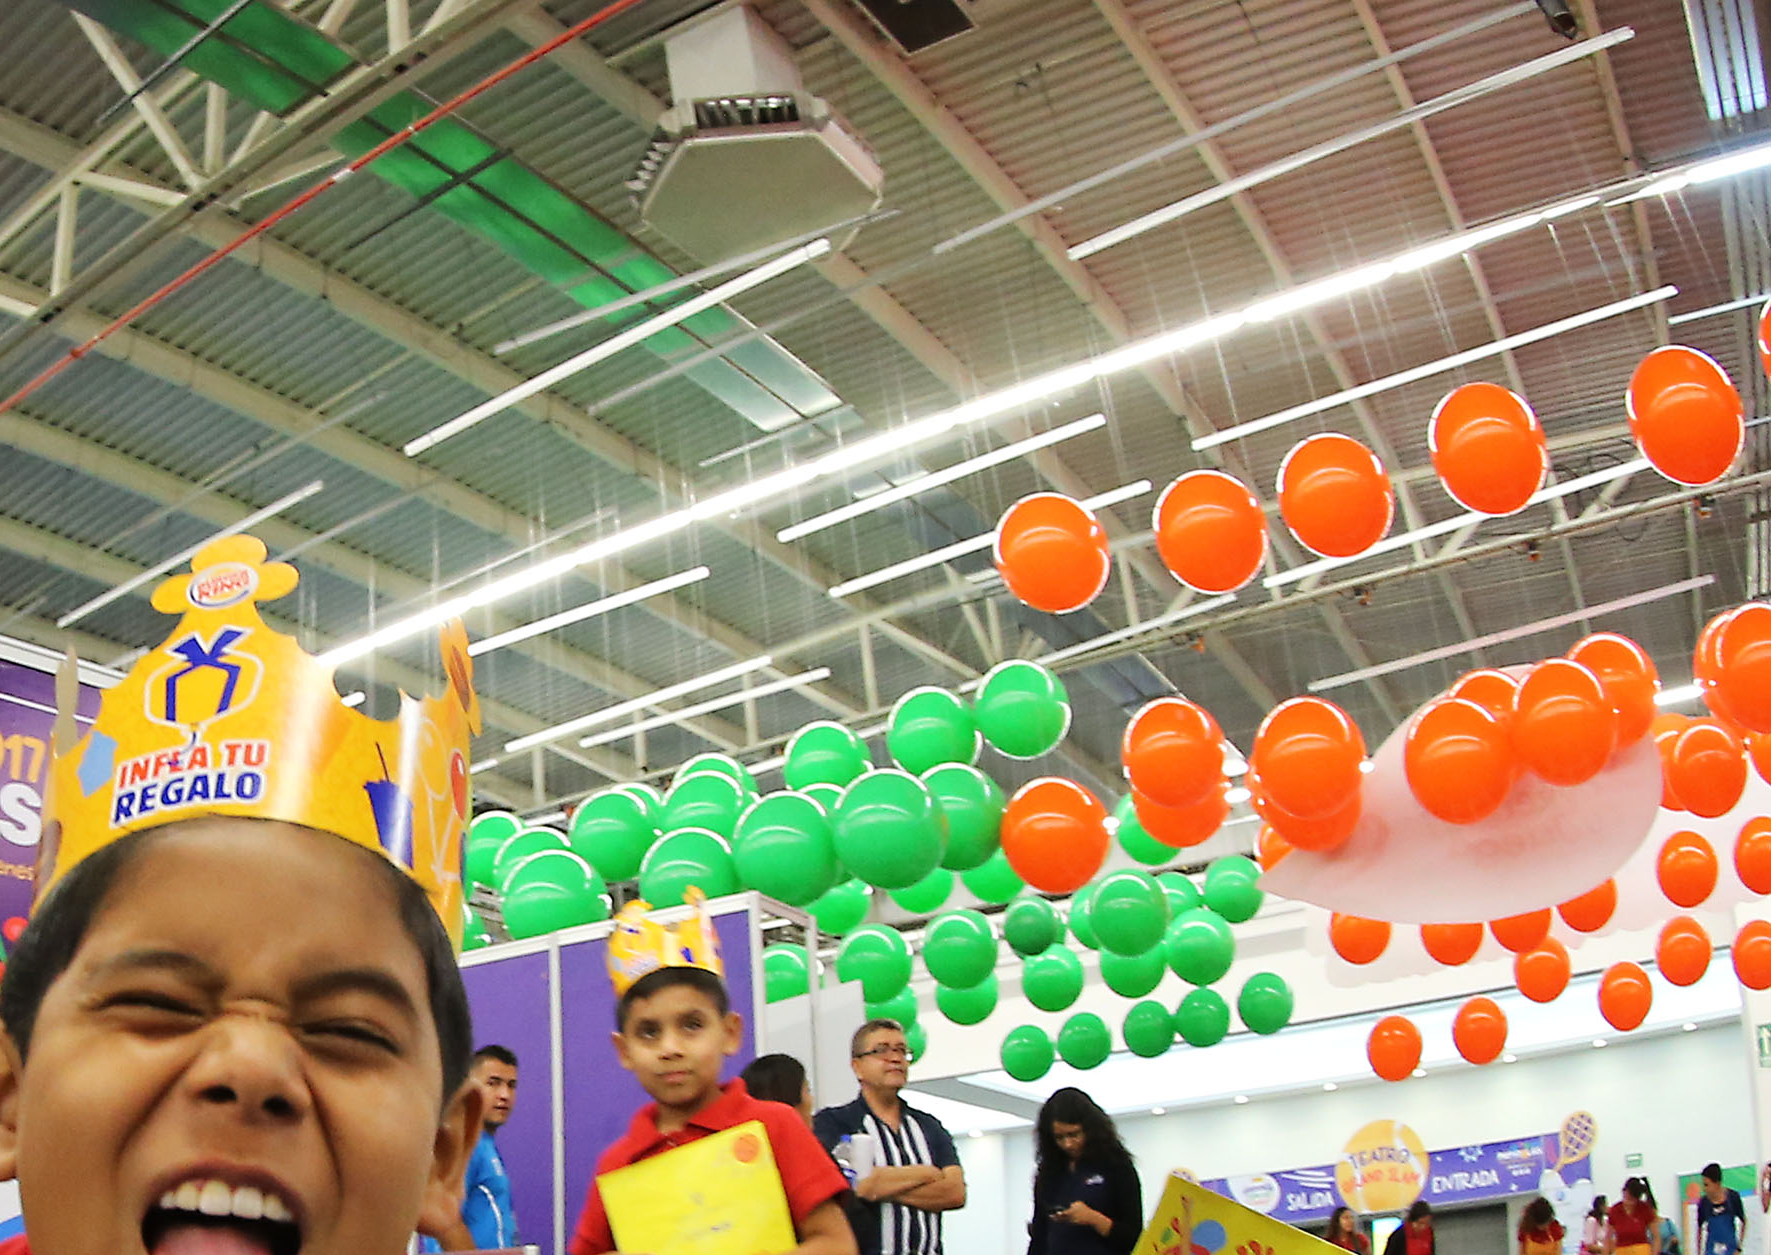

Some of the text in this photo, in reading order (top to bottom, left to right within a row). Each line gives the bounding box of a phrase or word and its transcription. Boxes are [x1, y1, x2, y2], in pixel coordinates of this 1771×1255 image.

[118, 745, 209, 788] INFLA
[113, 771, 262, 825] REGALO
[1348, 1147, 1411, 1168] TEATRO
[1432, 1169, 1500, 1194] ENTRADA
[1286, 1190, 1335, 1212] SALIDA
